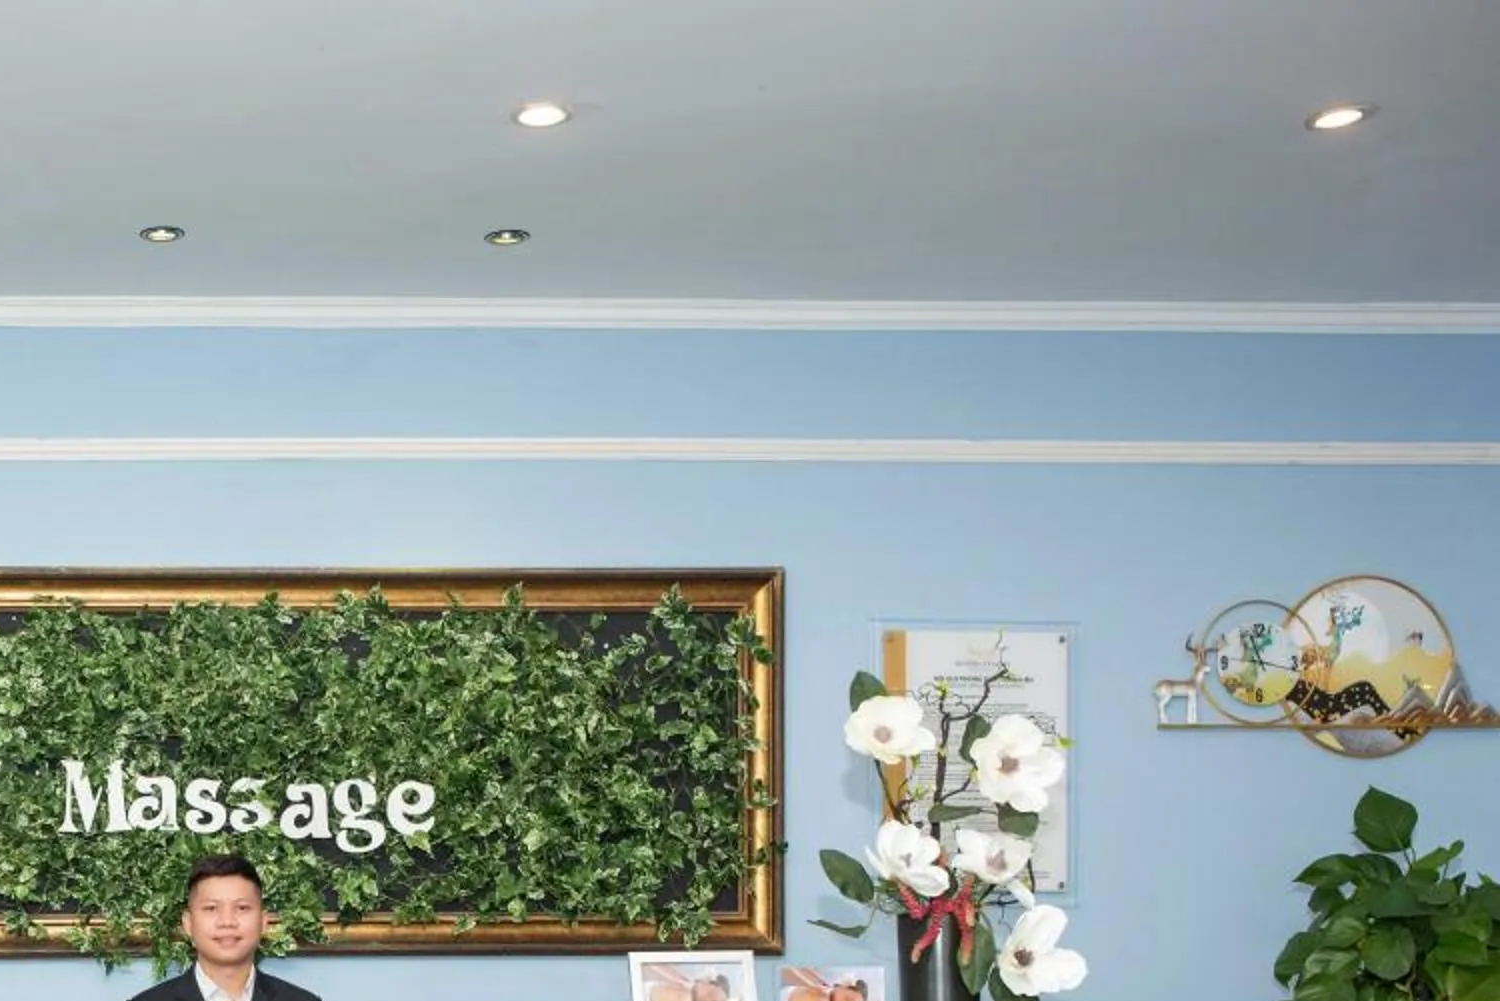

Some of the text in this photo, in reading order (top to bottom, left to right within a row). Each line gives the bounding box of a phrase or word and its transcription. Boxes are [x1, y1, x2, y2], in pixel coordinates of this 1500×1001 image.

[1220, 655, 1298, 670] 9 3
[1255, 687, 1263, 702] 6
[58, 759, 436, 853] Massage
